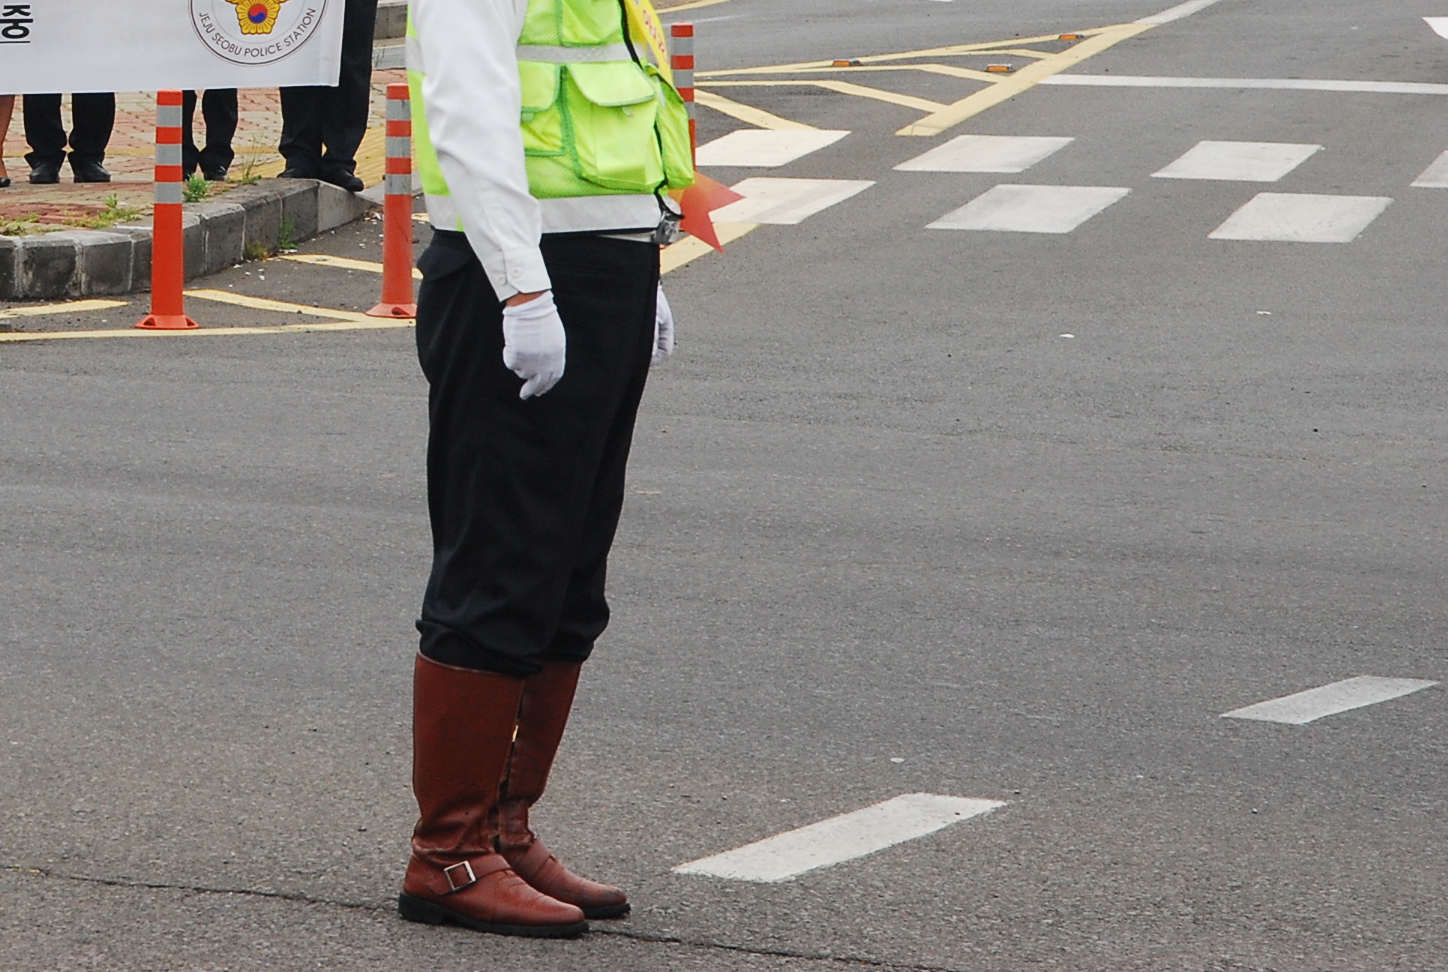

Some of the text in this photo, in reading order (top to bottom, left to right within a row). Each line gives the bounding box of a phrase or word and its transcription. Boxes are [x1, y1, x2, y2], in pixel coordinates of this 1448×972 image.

[199, 7, 317, 58] JEJU SEOBU POLICE STATION
